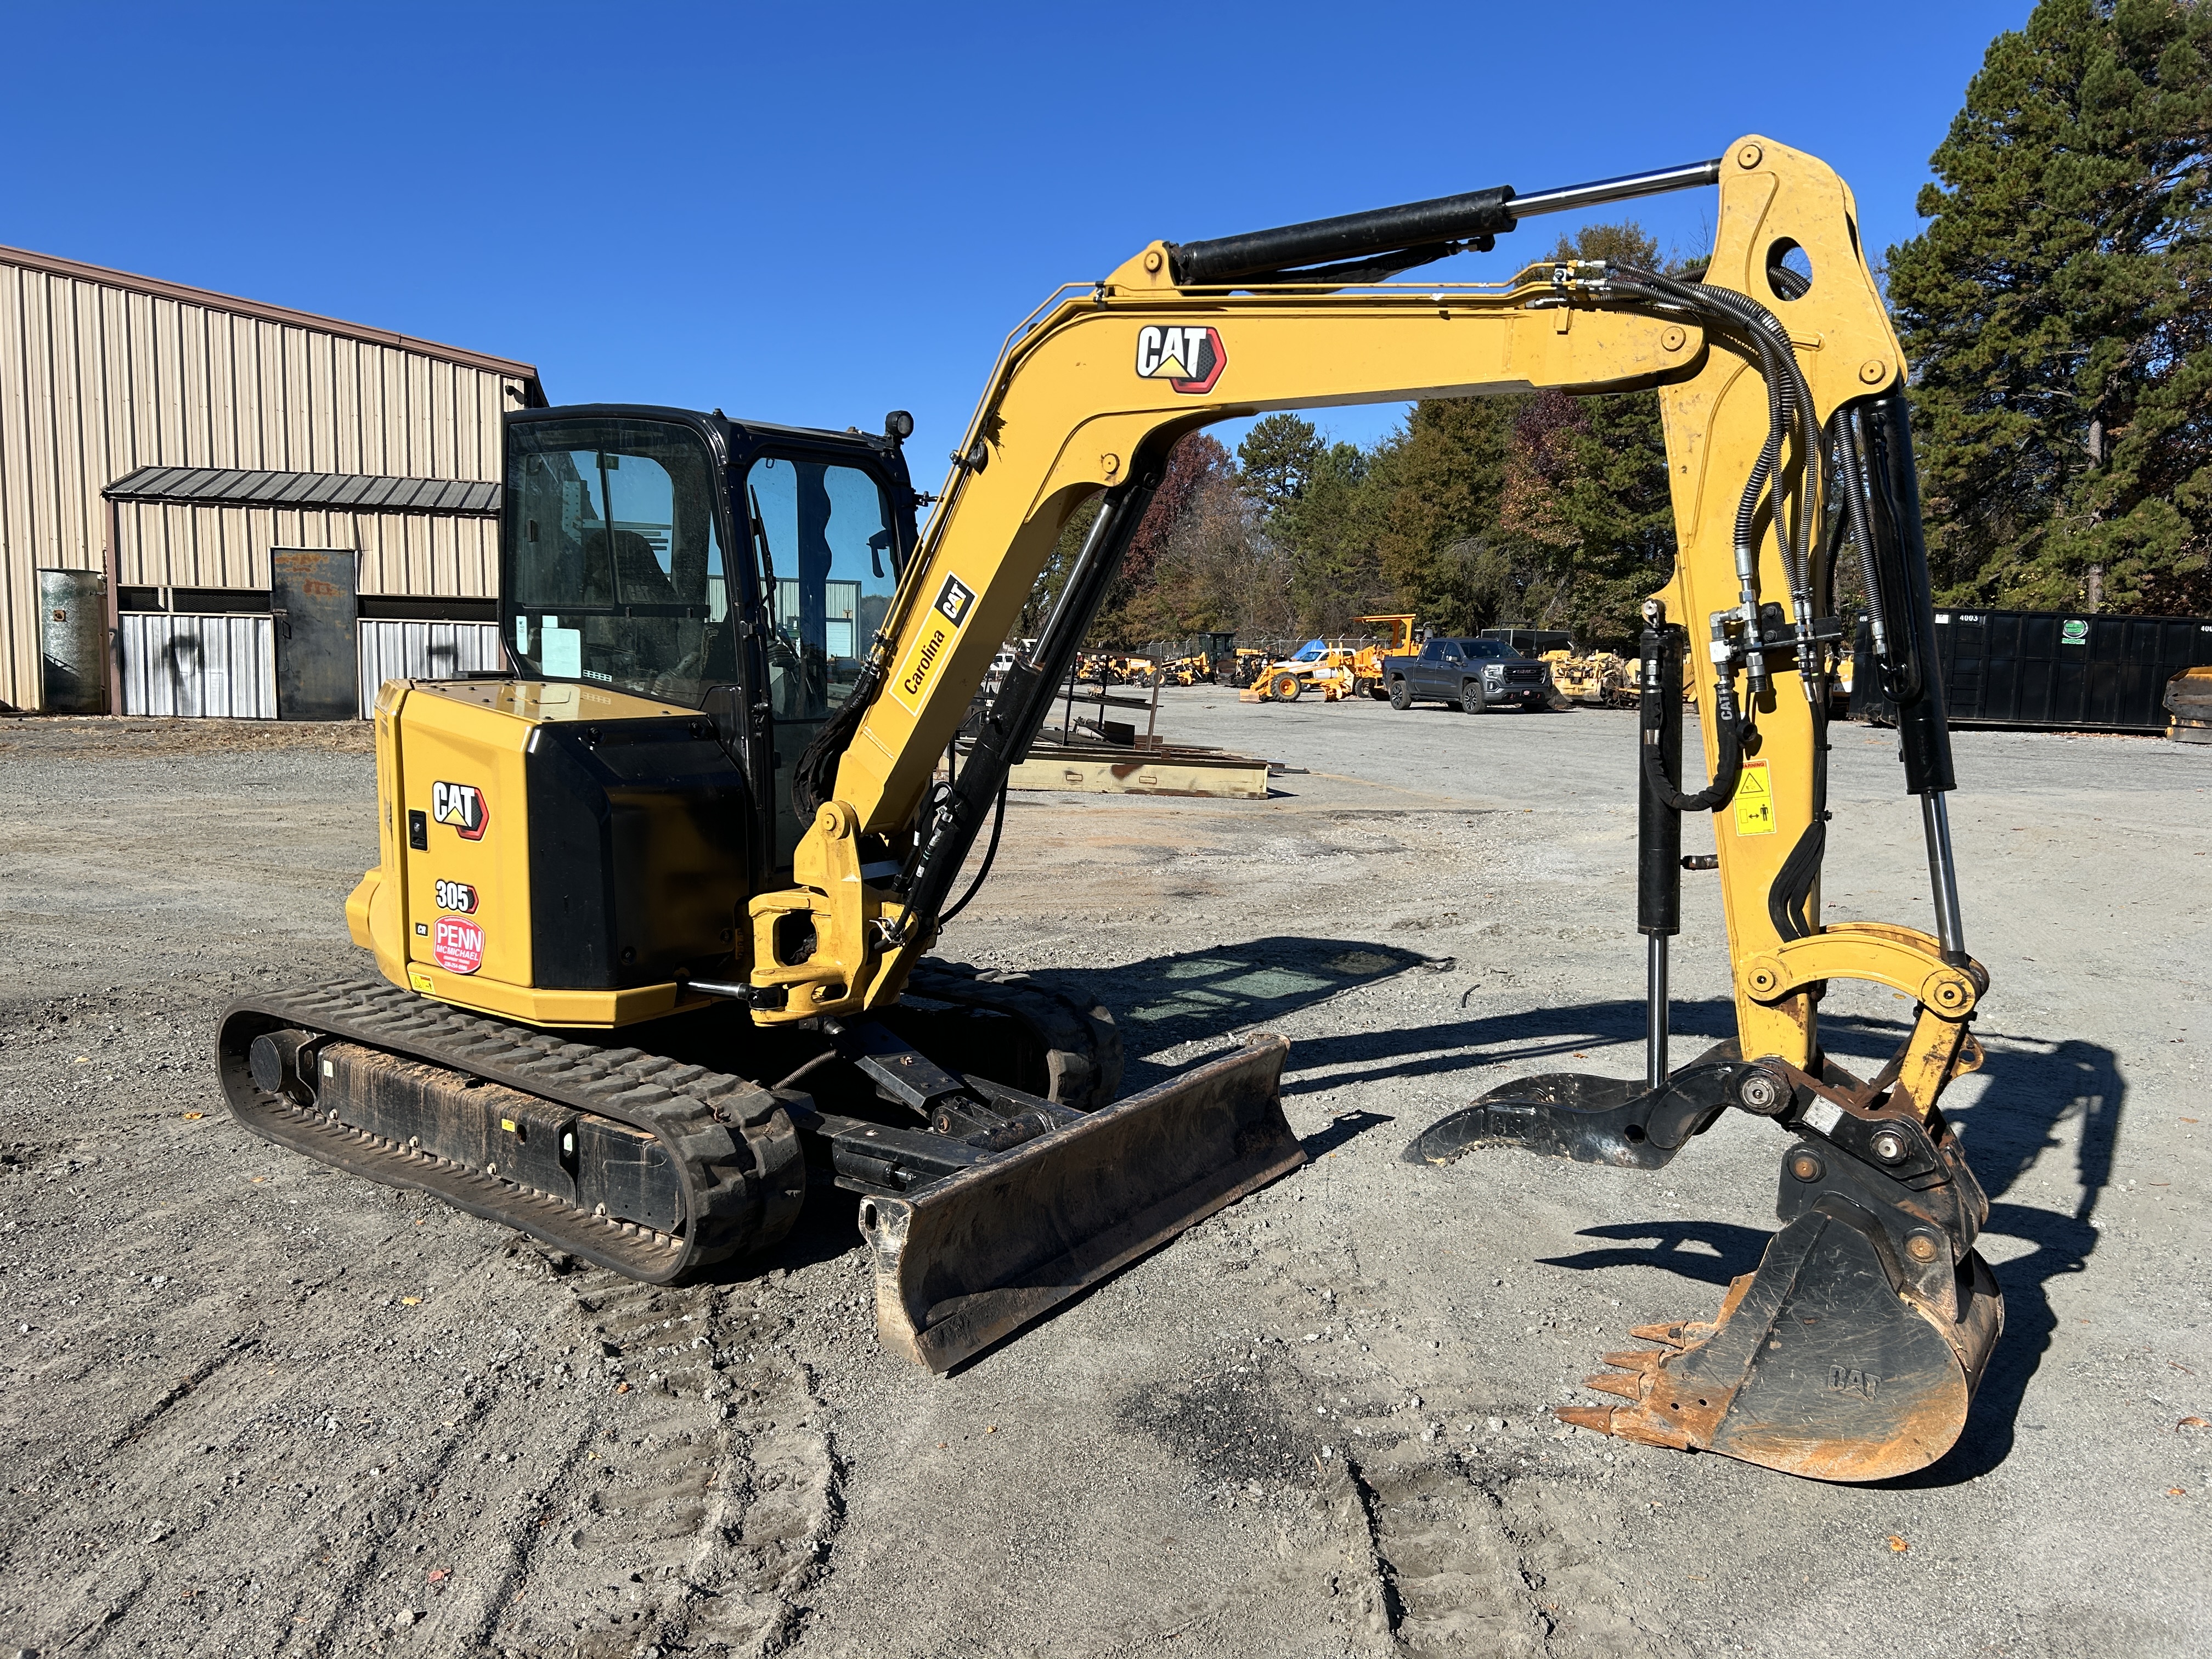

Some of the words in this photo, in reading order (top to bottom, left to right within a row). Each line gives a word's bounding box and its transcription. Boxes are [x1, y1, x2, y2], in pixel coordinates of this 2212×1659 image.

[1137, 326, 1206, 378] CAT
[904, 630, 945, 695] Carolina
[943, 582, 967, 619] CAT
[433, 782, 475, 827] CAT
[436, 880, 469, 911] 305
[417, 925, 426, 934] CR
[437, 923, 482, 952] PENN
[436, 944, 478, 961] MCMICHAEL
[1828, 1364, 1882, 1401] CAT
